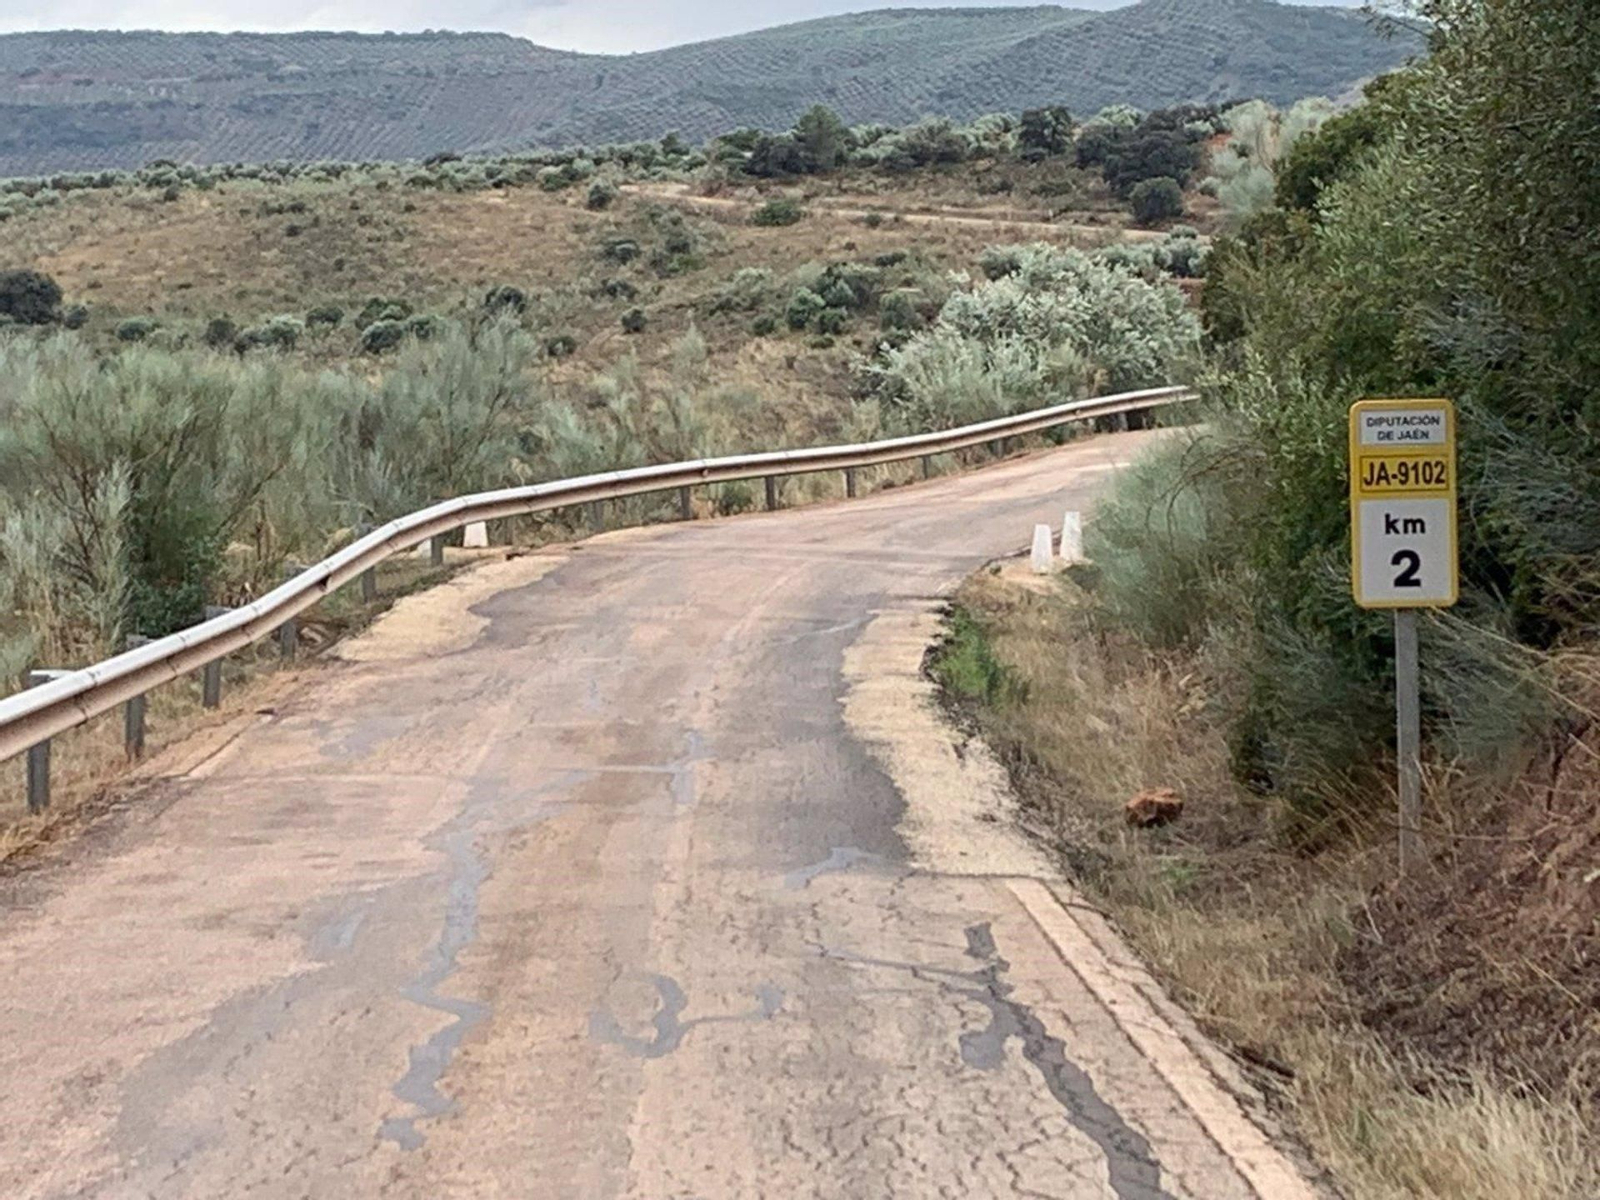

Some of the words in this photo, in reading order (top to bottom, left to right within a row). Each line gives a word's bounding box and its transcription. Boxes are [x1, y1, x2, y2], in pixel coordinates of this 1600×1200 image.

[1366, 414, 1440, 427] DIPUTACIÓN
[1377, 431, 1394, 441] DE
[1397, 428, 1430, 440] JAÉN
[1363, 460, 1445, 486] JA-9102
[1384, 513, 1426, 535] km
[1390, 549, 1422, 588] 2
